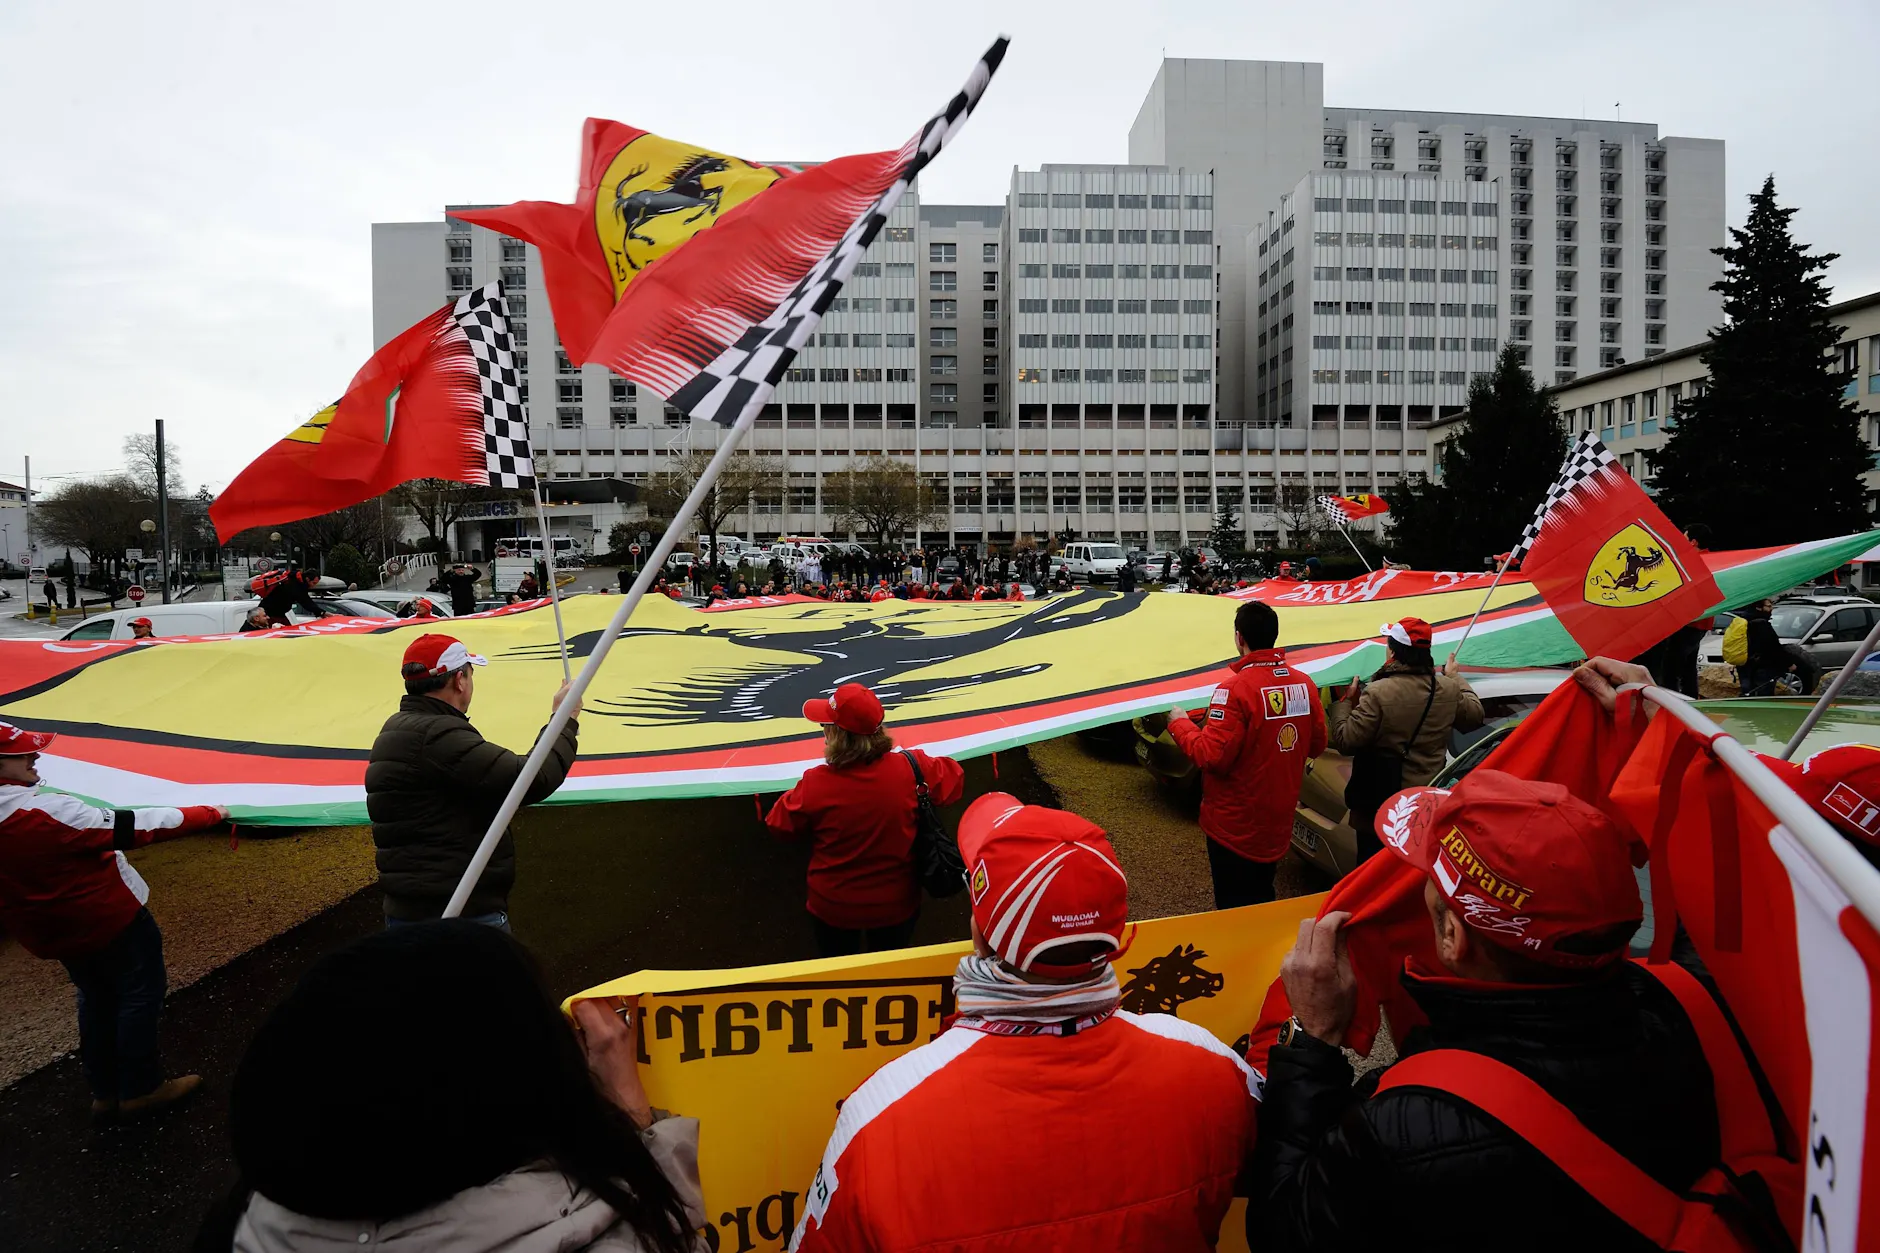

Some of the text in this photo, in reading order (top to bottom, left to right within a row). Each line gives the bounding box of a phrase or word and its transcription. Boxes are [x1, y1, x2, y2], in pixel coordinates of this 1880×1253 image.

[128, 590, 145, 598] STOP
[1858, 807, 1879, 828] 1
[1440, 824, 1534, 911] Ferrari
[1051, 911, 1100, 923] MUBADALA
[1060, 920, 1095, 929] ABU DHABI
